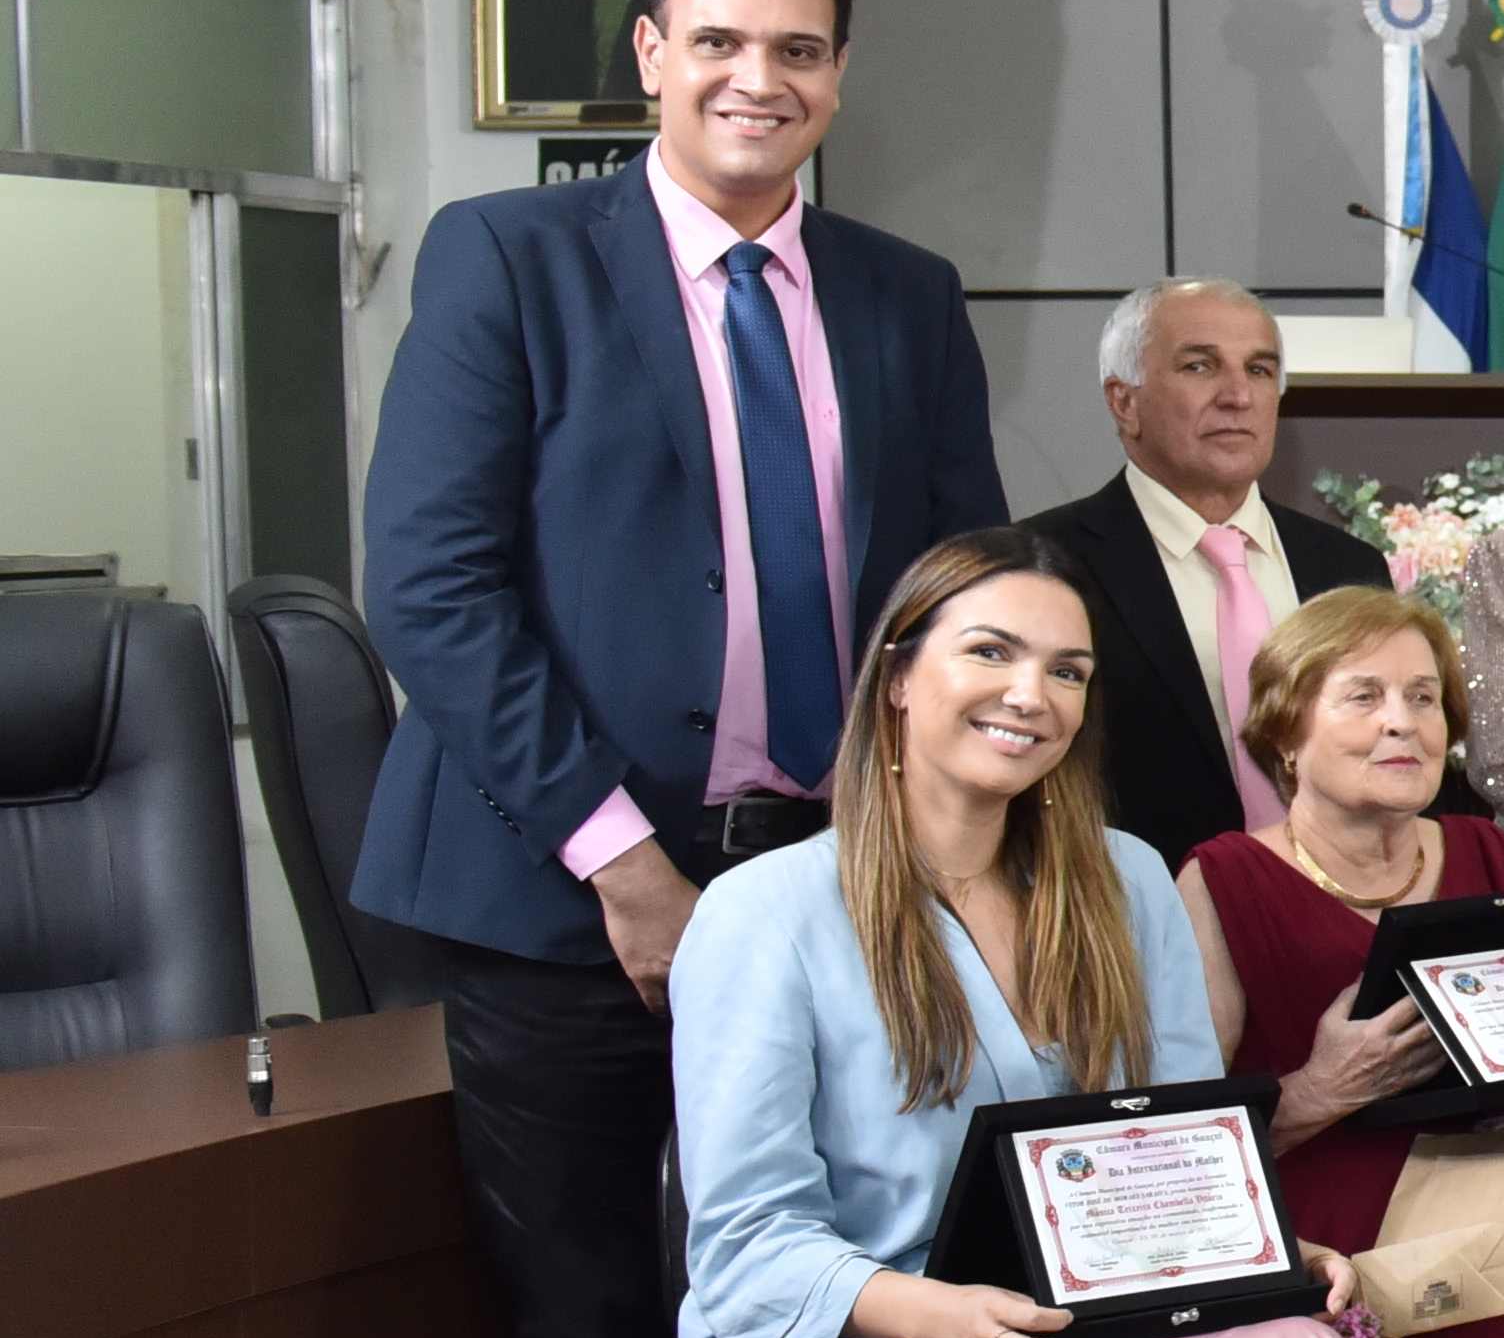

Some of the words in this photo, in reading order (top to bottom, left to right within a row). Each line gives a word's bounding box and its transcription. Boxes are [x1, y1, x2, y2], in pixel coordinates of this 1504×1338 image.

[1132, 1136, 1179, 1151] Municipal
[1178, 1135, 1190, 1145] de
[1106, 1167, 1125, 1178] Dia
[1125, 1159, 1182, 1176] Internacional
[1181, 1158, 1193, 1169] da
[1194, 1155, 1224, 1168] Mulher
